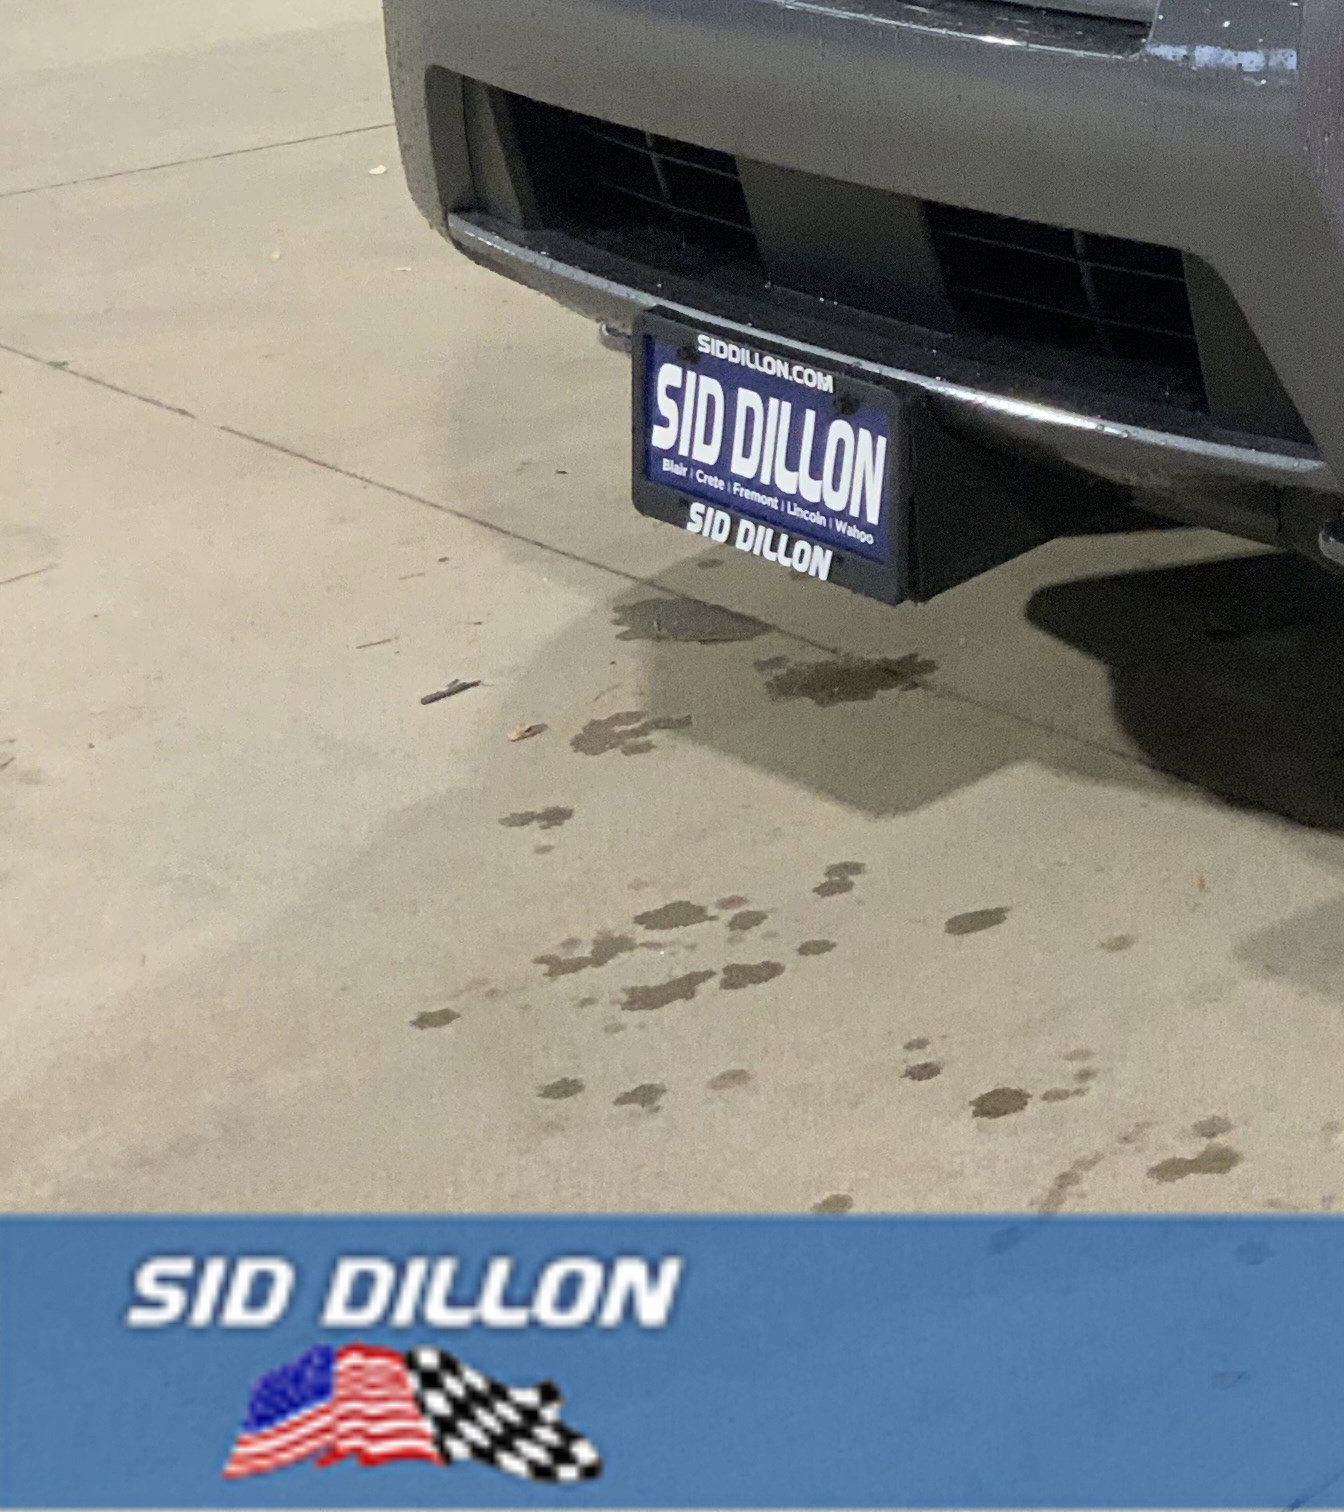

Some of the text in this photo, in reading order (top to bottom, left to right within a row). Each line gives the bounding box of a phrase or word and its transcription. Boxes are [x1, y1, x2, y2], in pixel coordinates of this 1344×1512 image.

[697, 334, 834, 394] SIDDILLON.COM
[651, 363, 888, 526] SID DILLON
[662, 458, 875, 545] Blair Crete Fremont Lincoln Wahoo
[686, 502, 833, 581] SID DILLON
